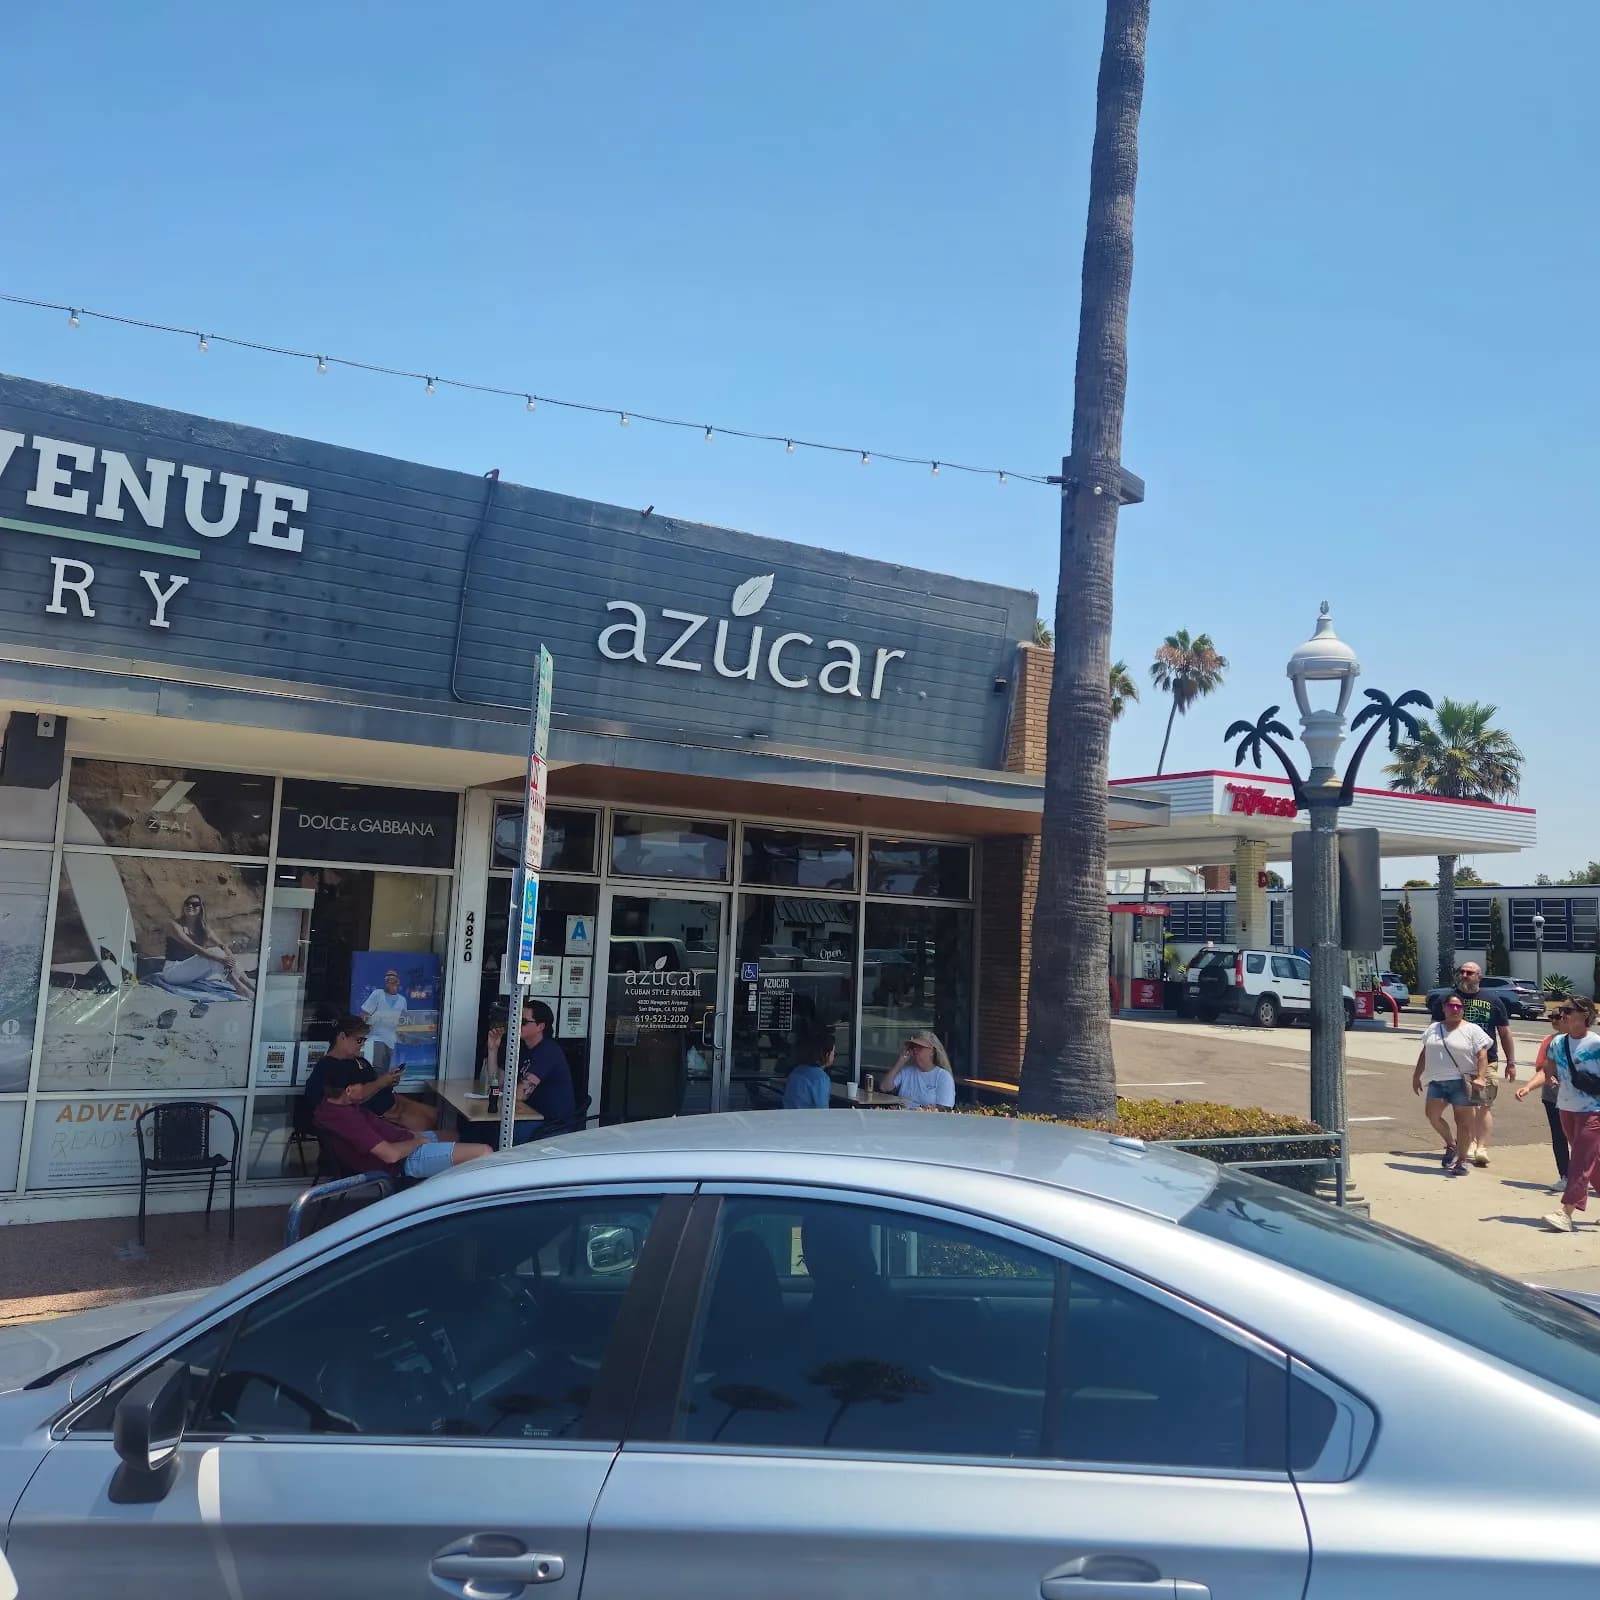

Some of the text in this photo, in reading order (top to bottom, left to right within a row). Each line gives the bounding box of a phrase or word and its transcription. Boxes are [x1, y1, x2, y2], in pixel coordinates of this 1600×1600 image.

[148, 818, 191, 833] ZEAL
[298, 814, 349, 832] DOLCE
[358, 819, 435, 837] GABBANA
[463, 911, 475, 962] 4820
[630, 988, 651, 996] CUBAN
[634, 1014, 689, 1023] 619-523-2020
